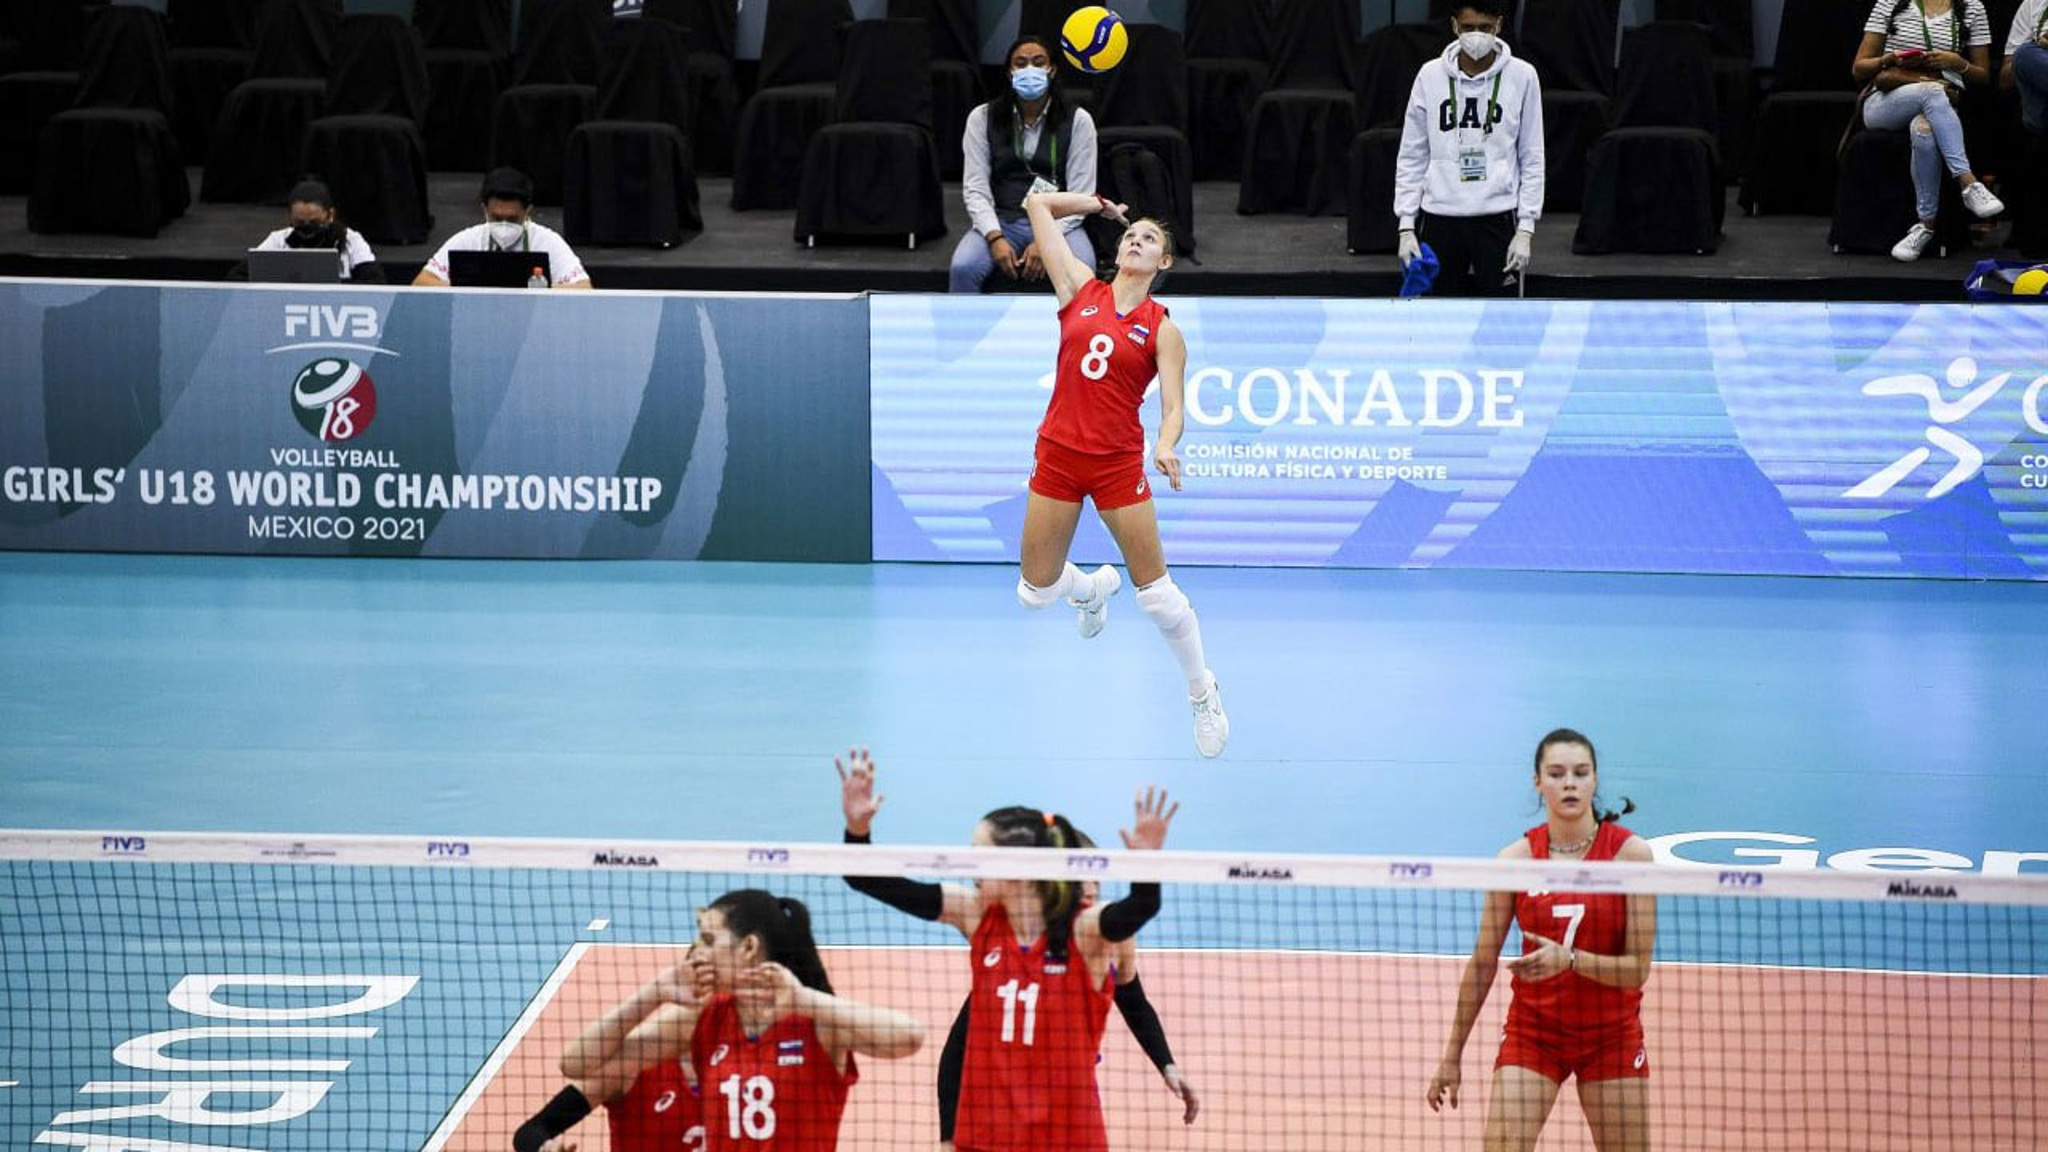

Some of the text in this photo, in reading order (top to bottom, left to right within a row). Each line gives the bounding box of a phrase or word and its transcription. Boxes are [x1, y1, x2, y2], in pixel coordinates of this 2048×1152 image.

[1439, 97, 1503, 132] GAP
[285, 305, 379, 338] FIVB
[1081, 333, 1114, 380] 8
[1186, 367, 1524, 427] CONADE
[270, 449, 399, 467] VOLLEYBALL
[1184, 442, 1413, 460] COMISIÓN NACIONAL DE
[1184, 461, 1447, 480] CULTURA FÍSICA Y DEPORTE
[140, 469, 215, 504] U18
[228, 471, 361, 507] WORLD
[375, 474, 662, 511] CHAMPIONSHIP
[249, 516, 425, 540] MEXICO 2021
[102, 836, 145, 850] FIVB
[1552, 904, 1585, 950] 7
[997, 979, 1039, 1046] 11
[719, 1073, 776, 1139] 18
